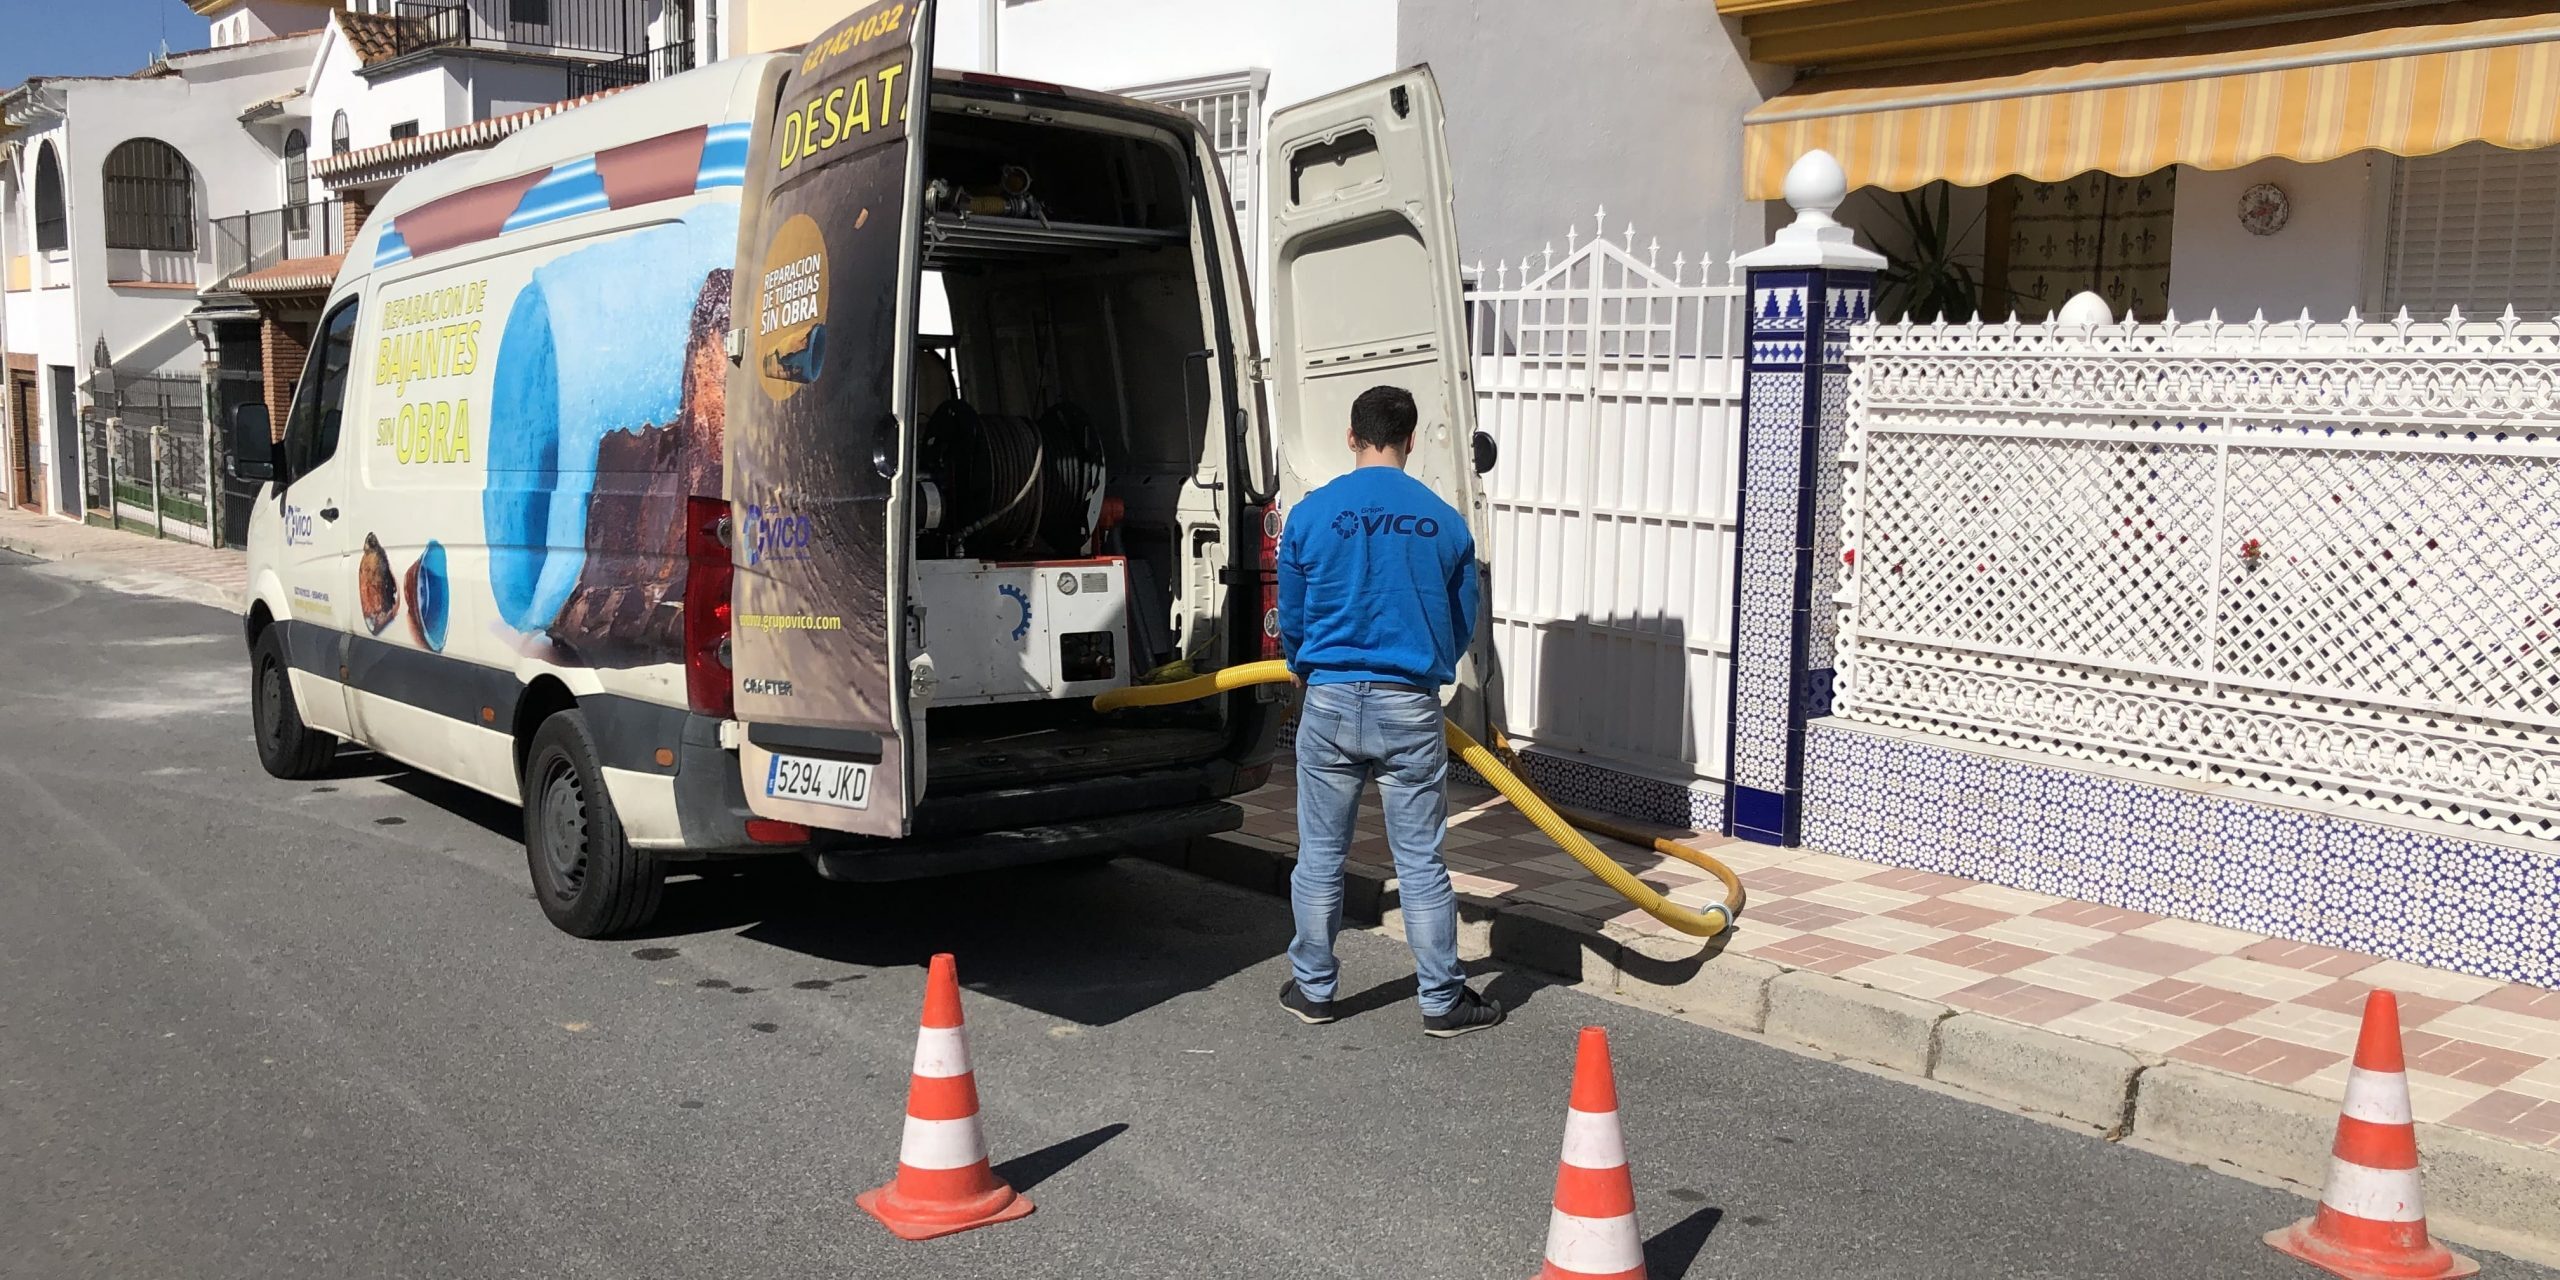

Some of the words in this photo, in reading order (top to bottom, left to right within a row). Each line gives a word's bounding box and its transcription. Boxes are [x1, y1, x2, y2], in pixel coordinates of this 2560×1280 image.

[801, 5, 904, 76] 627421032
[763, 291, 774, 311] DE
[776, 274, 820, 304] TUBERIAS
[764, 253, 821, 291] REPARACION
[382, 284, 465, 331] REPARACION
[465, 279, 488, 314] DE
[760, 309, 779, 335] SIN
[781, 294, 818, 326] OBRA
[376, 320, 481, 398] BAJANTES
[376, 418, 396, 446] SIN
[396, 398, 471, 465] OBRA
[766, 514, 811, 548] VICO
[1361, 513, 1439, 537] VICO
[739, 613, 841, 633] www.grupovico.com
[778, 760, 822, 796] 5294
[828, 764, 867, 802] JKD
